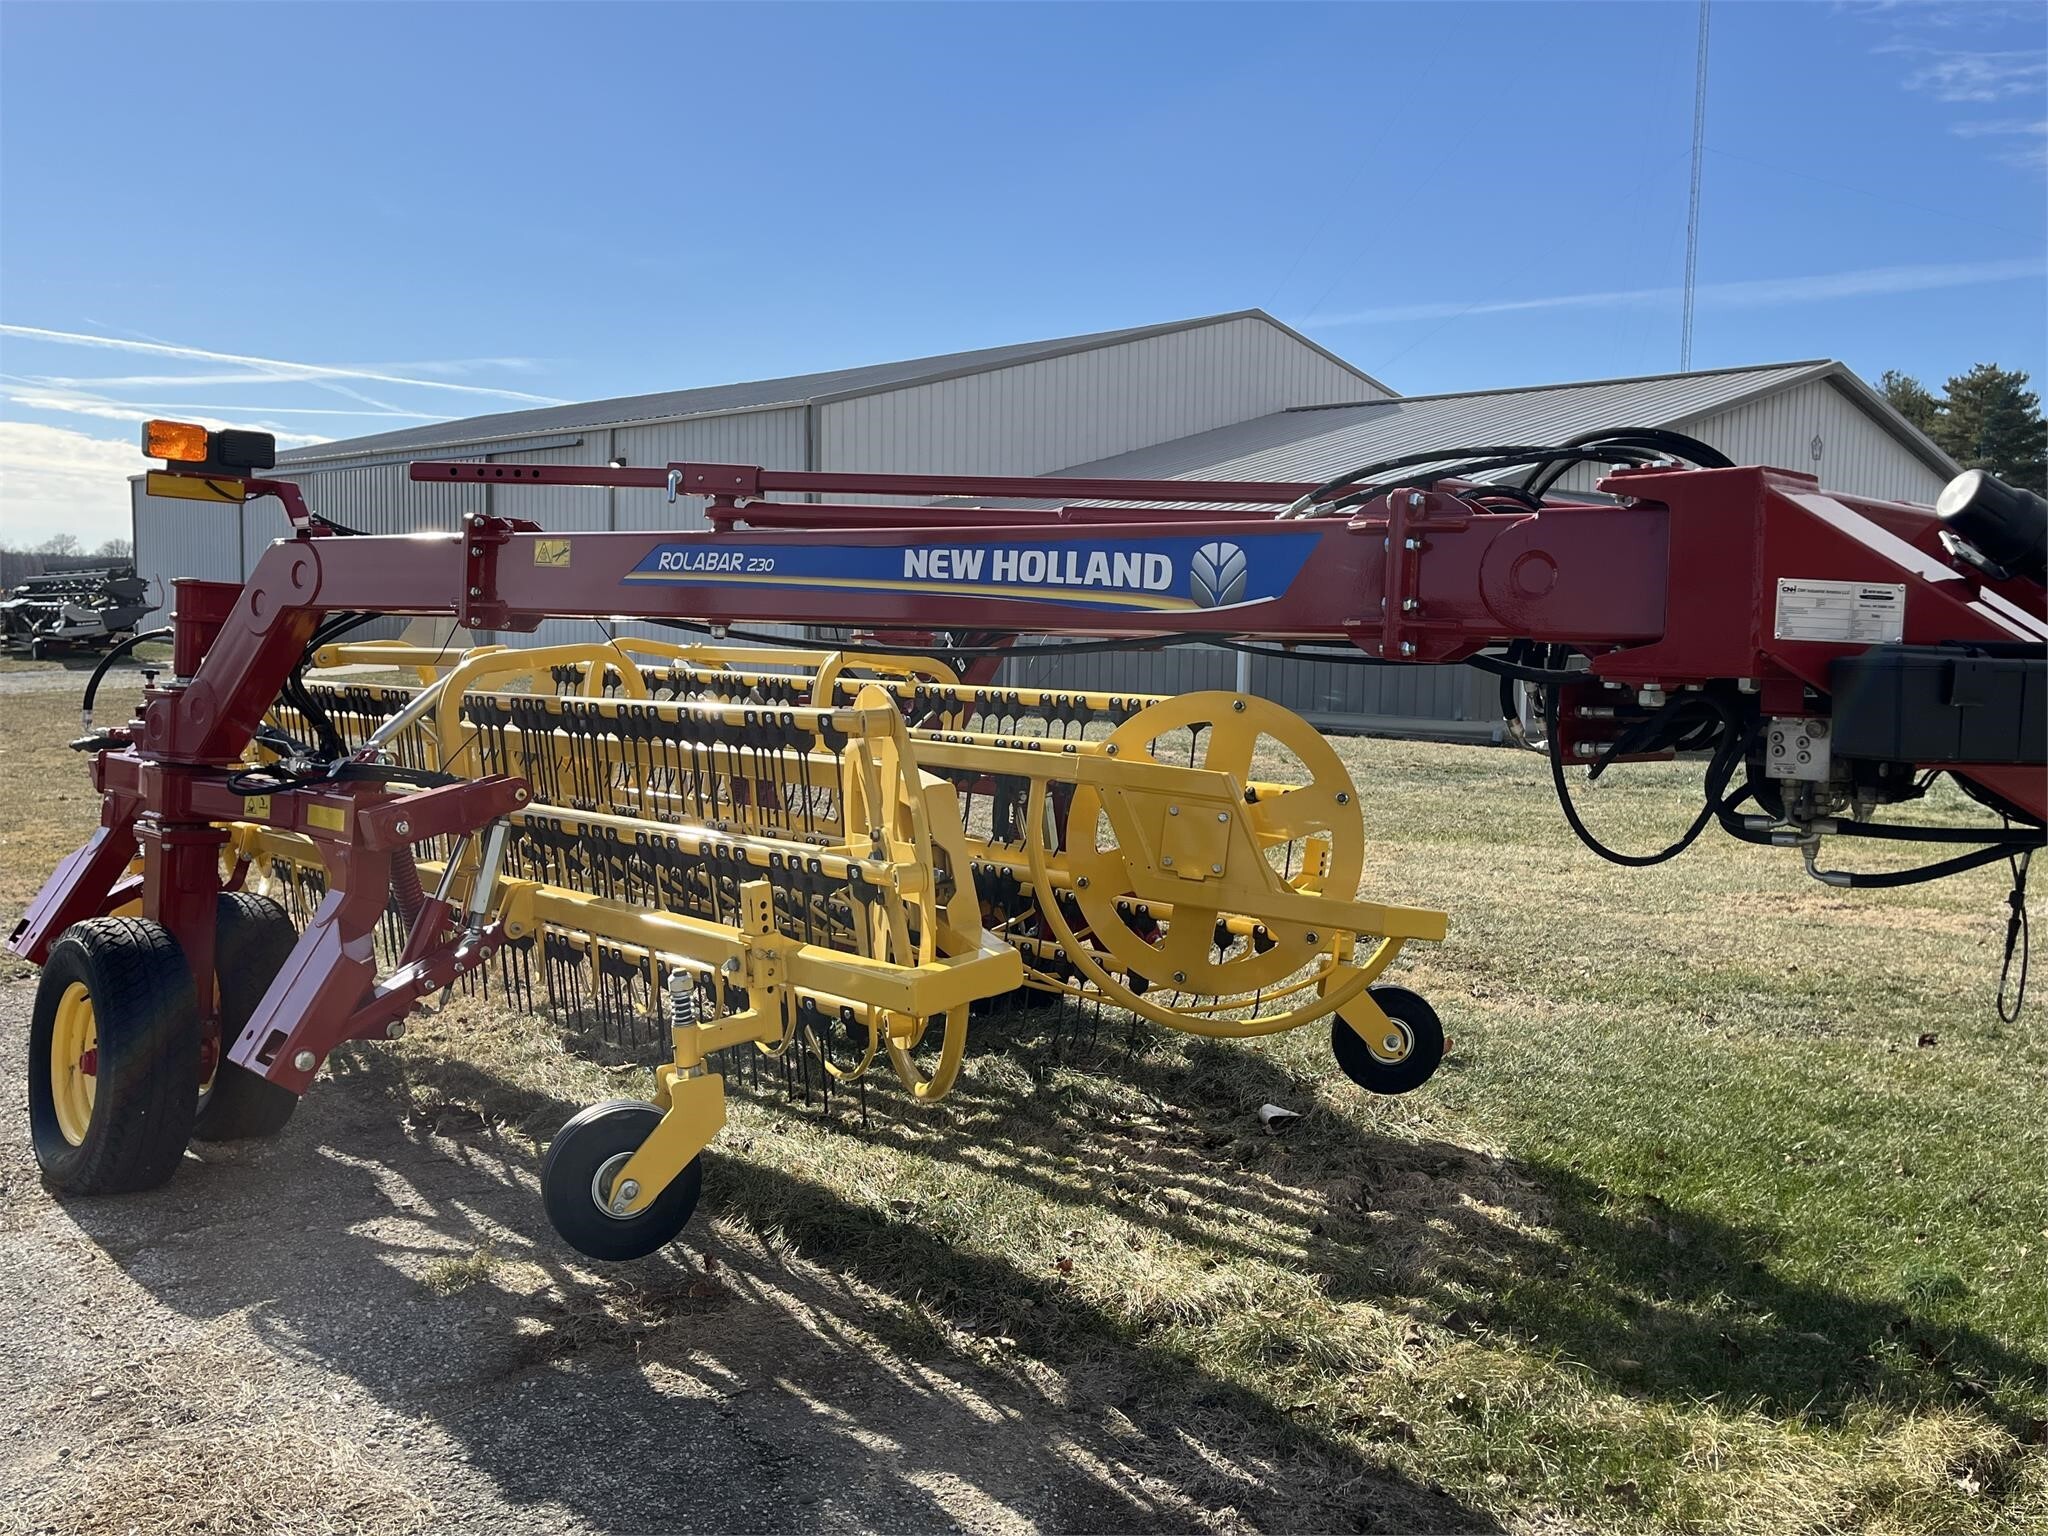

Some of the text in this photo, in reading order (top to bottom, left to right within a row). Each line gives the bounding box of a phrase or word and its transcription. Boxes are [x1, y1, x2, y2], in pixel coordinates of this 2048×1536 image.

[658, 551, 775, 572] ROLABAR 230
[903, 548, 1173, 591] NEW HOLLAND
